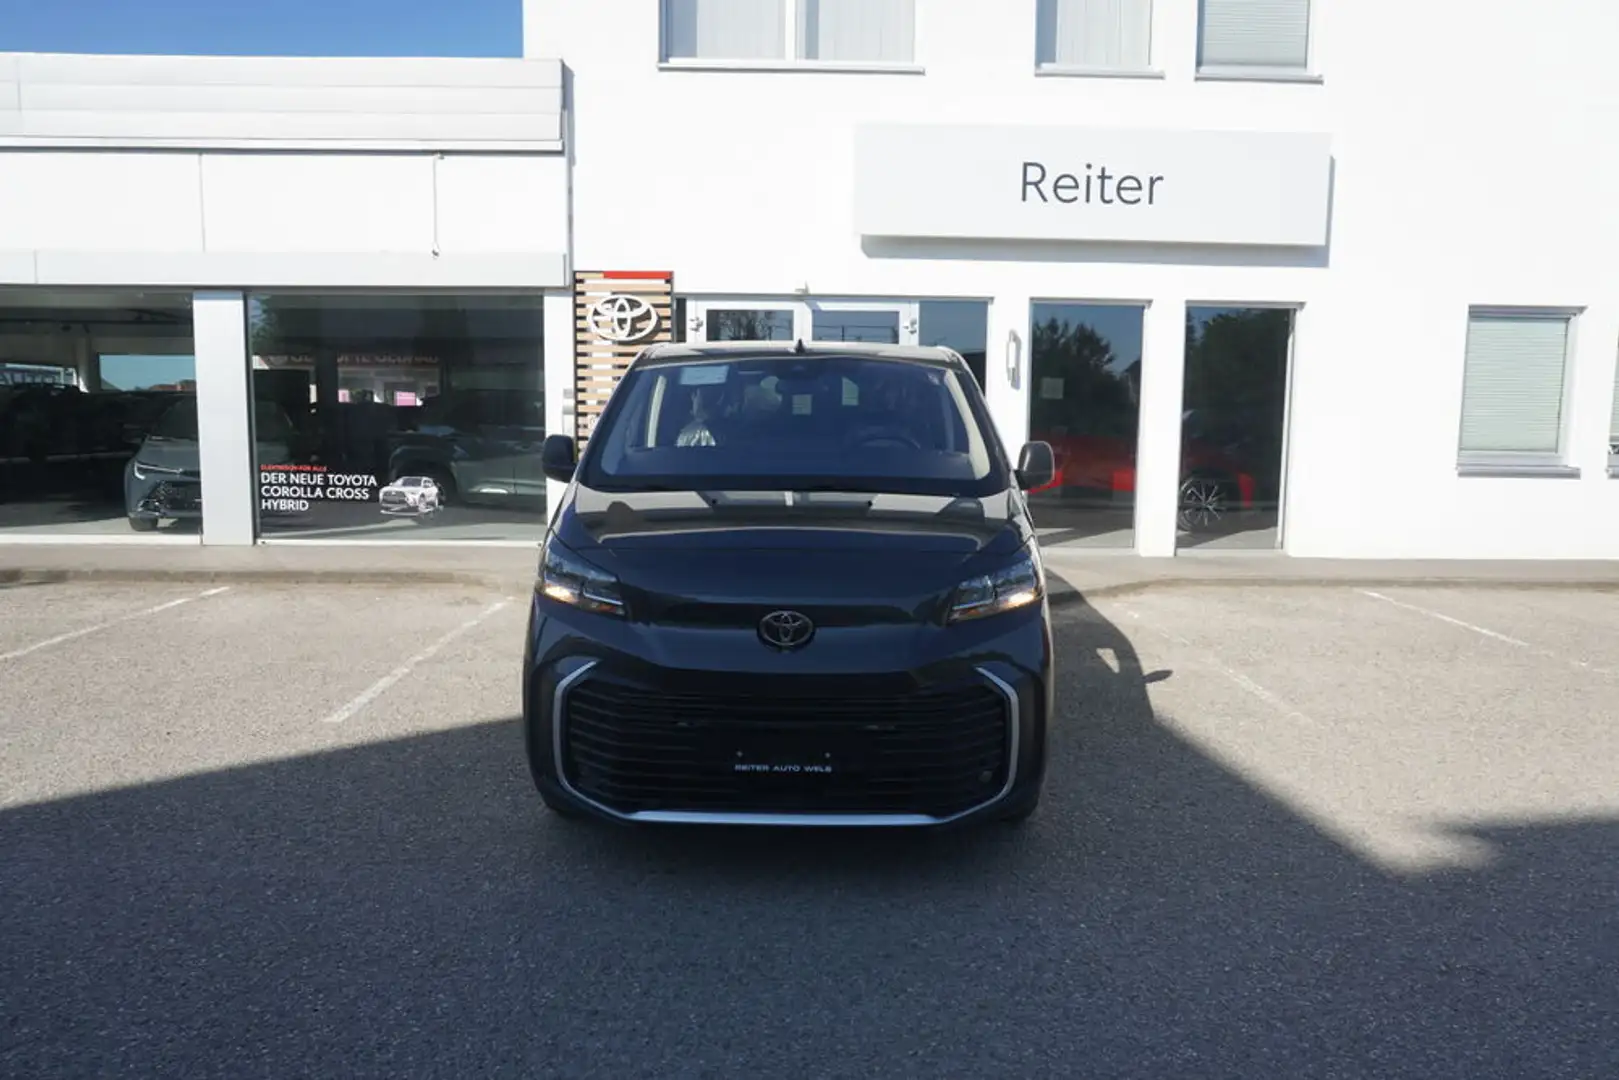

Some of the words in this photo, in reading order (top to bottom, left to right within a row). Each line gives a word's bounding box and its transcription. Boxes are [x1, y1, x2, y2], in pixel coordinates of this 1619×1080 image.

[1021, 161, 1164, 205] Reiter
[260, 472, 287, 485] DER
[290, 472, 325, 485] NEUE
[327, 474, 378, 487] TOYOTA
[260, 485, 324, 499] COROLLA
[326, 487, 370, 500] CROSS
[261, 499, 310, 511] HYBRID
[734, 764, 770, 773] REITER
[772, 764, 801, 773] AUTO
